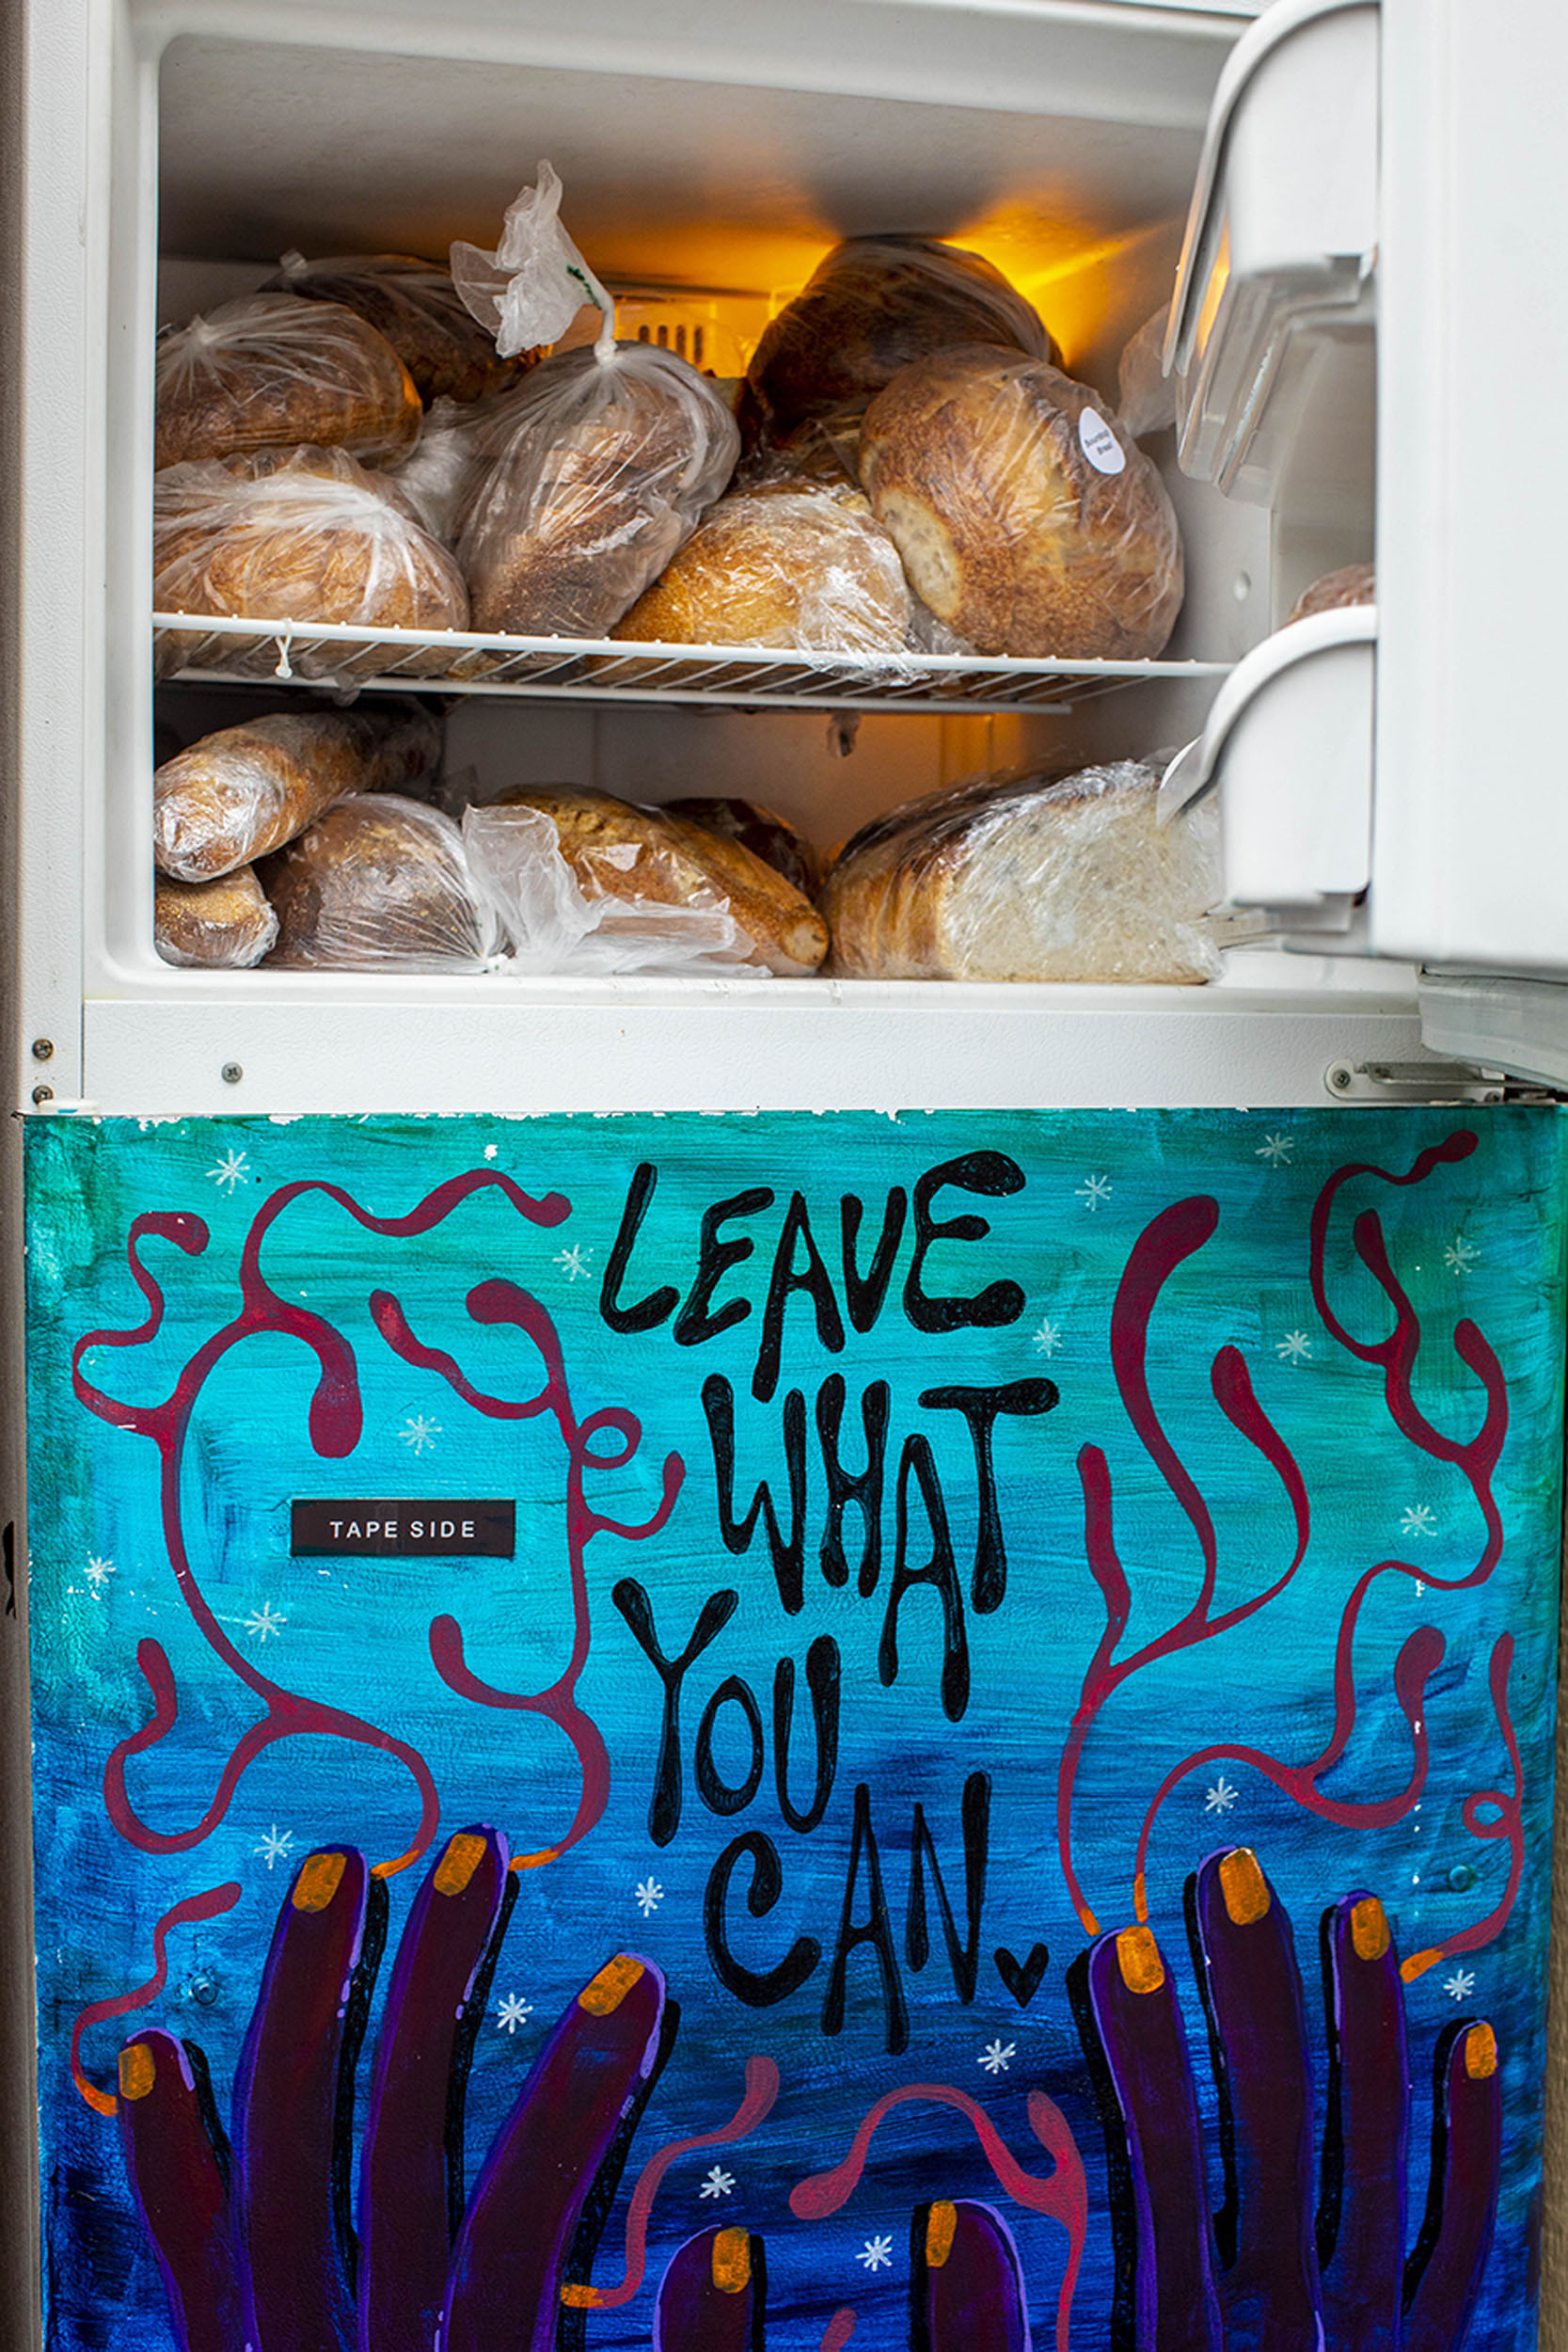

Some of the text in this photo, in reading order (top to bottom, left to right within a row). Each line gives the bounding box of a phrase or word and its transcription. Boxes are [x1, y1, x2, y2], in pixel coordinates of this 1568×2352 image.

[600, 1150, 1026, 1403] LEAVE
[329, 1520, 476, 1539] TAPE SIDE
[701, 1373, 1060, 1723] WHAT
[611, 1577, 841, 1847] YOU
[703, 1769, 992, 2056] CAN
